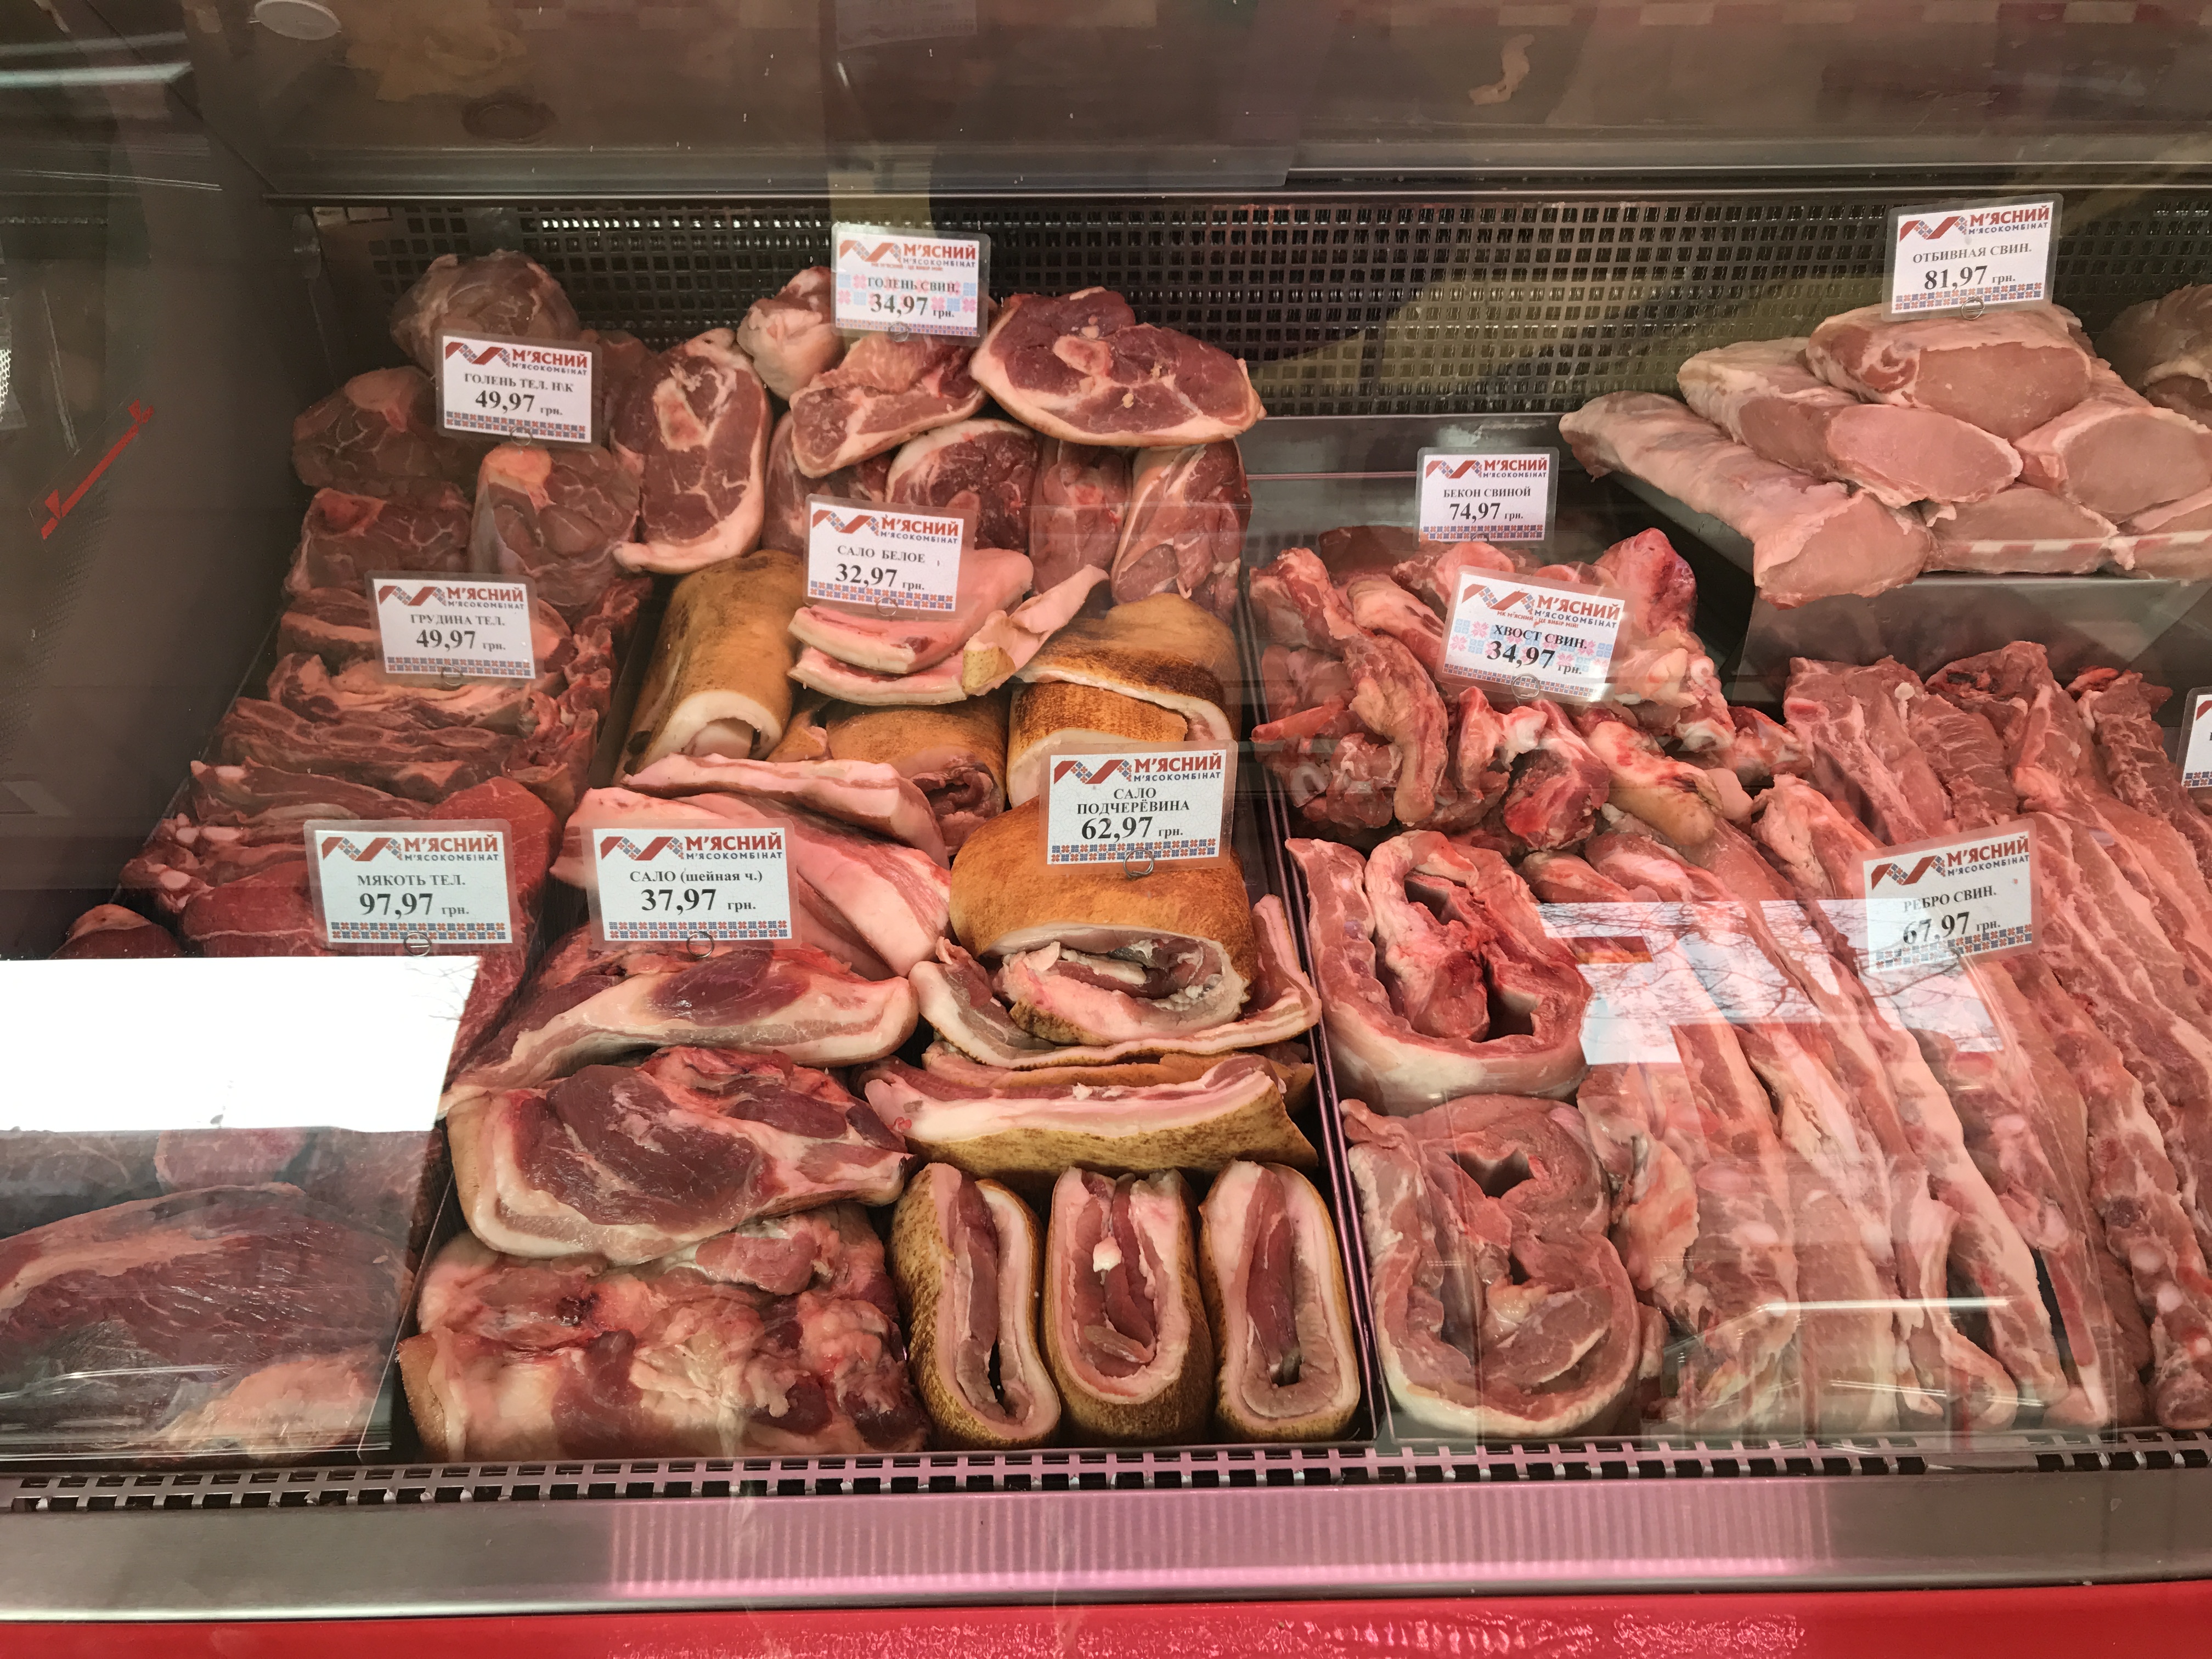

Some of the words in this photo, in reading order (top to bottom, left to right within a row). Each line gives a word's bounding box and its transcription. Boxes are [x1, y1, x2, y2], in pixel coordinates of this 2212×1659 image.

[1970, 205, 2050, 227] М'ЯСНИЙ
[1968, 222, 2049, 235] М'ЯСОКОМБІНАТ
[904, 243, 976, 260] М'ЯСНИЙ
[1913, 247, 1986, 263] ОТБИВНАЯ
[1990, 243, 2032, 255] СВИН.
[904, 258, 975, 268] М'ЯСОКОМБІНАТ
[868, 276, 917, 290] ГОЛЕНЬ
[921, 280, 958, 293] СВИН.
[1925, 266, 1987, 290] 81,97
[1992, 274, 2016, 285] грн.
[871, 294, 928, 318] 34,97
[933, 310, 955, 319] грн.
[512, 349, 587, 368] М'ЯСНИЙ
[512, 362, 587, 375] М'ЯСОКОМБІНАТ
[464, 373, 516, 387] ГОЛЕНЬ
[520, 379, 549, 390] ТЕЛ.
[475, 391, 534, 414] 49,97
[540, 407, 563, 417] грн.
[1485, 457, 1547, 471] М'ЯСНИЙ
[1443, 489, 1481, 498] БЕКОН
[1484, 486, 1531, 497] СВИНОЙ
[1449, 503, 1500, 523] 74,97
[1504, 512, 1523, 521] грн.
[882, 517, 958, 536] М'ЯСНИЙ
[881, 532, 957, 544] М'ЯСОКОМБІНАТ
[838, 545, 874, 557] САЛО
[882, 550, 925, 563] БЕЛОЕ
[836, 563, 898, 588] 32,97
[902, 582, 924, 591] грн.
[447, 587, 523, 602] М'ЯСНИЙ
[447, 601, 524, 610] М'ЯСОКОМБІНАТ
[1537, 595, 1621, 620] М'ЯСНИЙ
[411, 614, 472, 625] ГРУДИНА
[476, 616, 505, 626] ТЕЛ.
[1535, 610, 1617, 628] М'ЯСОКОМБІНАТ
[416, 629, 476, 652] 49,97
[483, 642, 506, 652] грн.
[1493, 624, 1542, 641] ХВОСТ
[1545, 633, 1587, 649] СВИН.
[1487, 640, 1555, 669] 34,97
[1558, 664, 1582, 675] грн.
[1135, 752, 1222, 773] М'ЯСНИЙ
[1134, 772, 1221, 782] М'ЯСОКОМБІНАТ
[1114, 787, 1156, 799] САЛО
[1077, 799, 1189, 816] ПОДЧЕРЁВИНА
[1082, 816, 1153, 843] 62,97
[1159, 828, 1183, 838] грн.
[403, 834, 498, 852] М'ЯСНИЙ
[685, 832, 782, 851] М'ЯСНИЙ
[1946, 835, 2029, 867] М'ЯСНИЙ
[1948, 855, 2029, 876] М'ЯСОКОМБІНАТ
[358, 875, 426, 886] МЯКОТЬ
[430, 874, 465, 885] ТЕЛ.
[630, 871, 676, 882] САЛО
[681, 871, 740, 883] (шейная
[745, 871, 762, 883] ч.)
[360, 893, 433, 919] 97,97
[442, 907, 469, 917] грн.
[641, 889, 716, 915] 37,97
[727, 902, 756, 912] грн.
[1904, 893, 1949, 913] РЕБРО
[1954, 885, 1996, 902] СВИН.
[1903, 911, 1970, 944] 67,97
[1976, 921, 2000, 933] грн.
